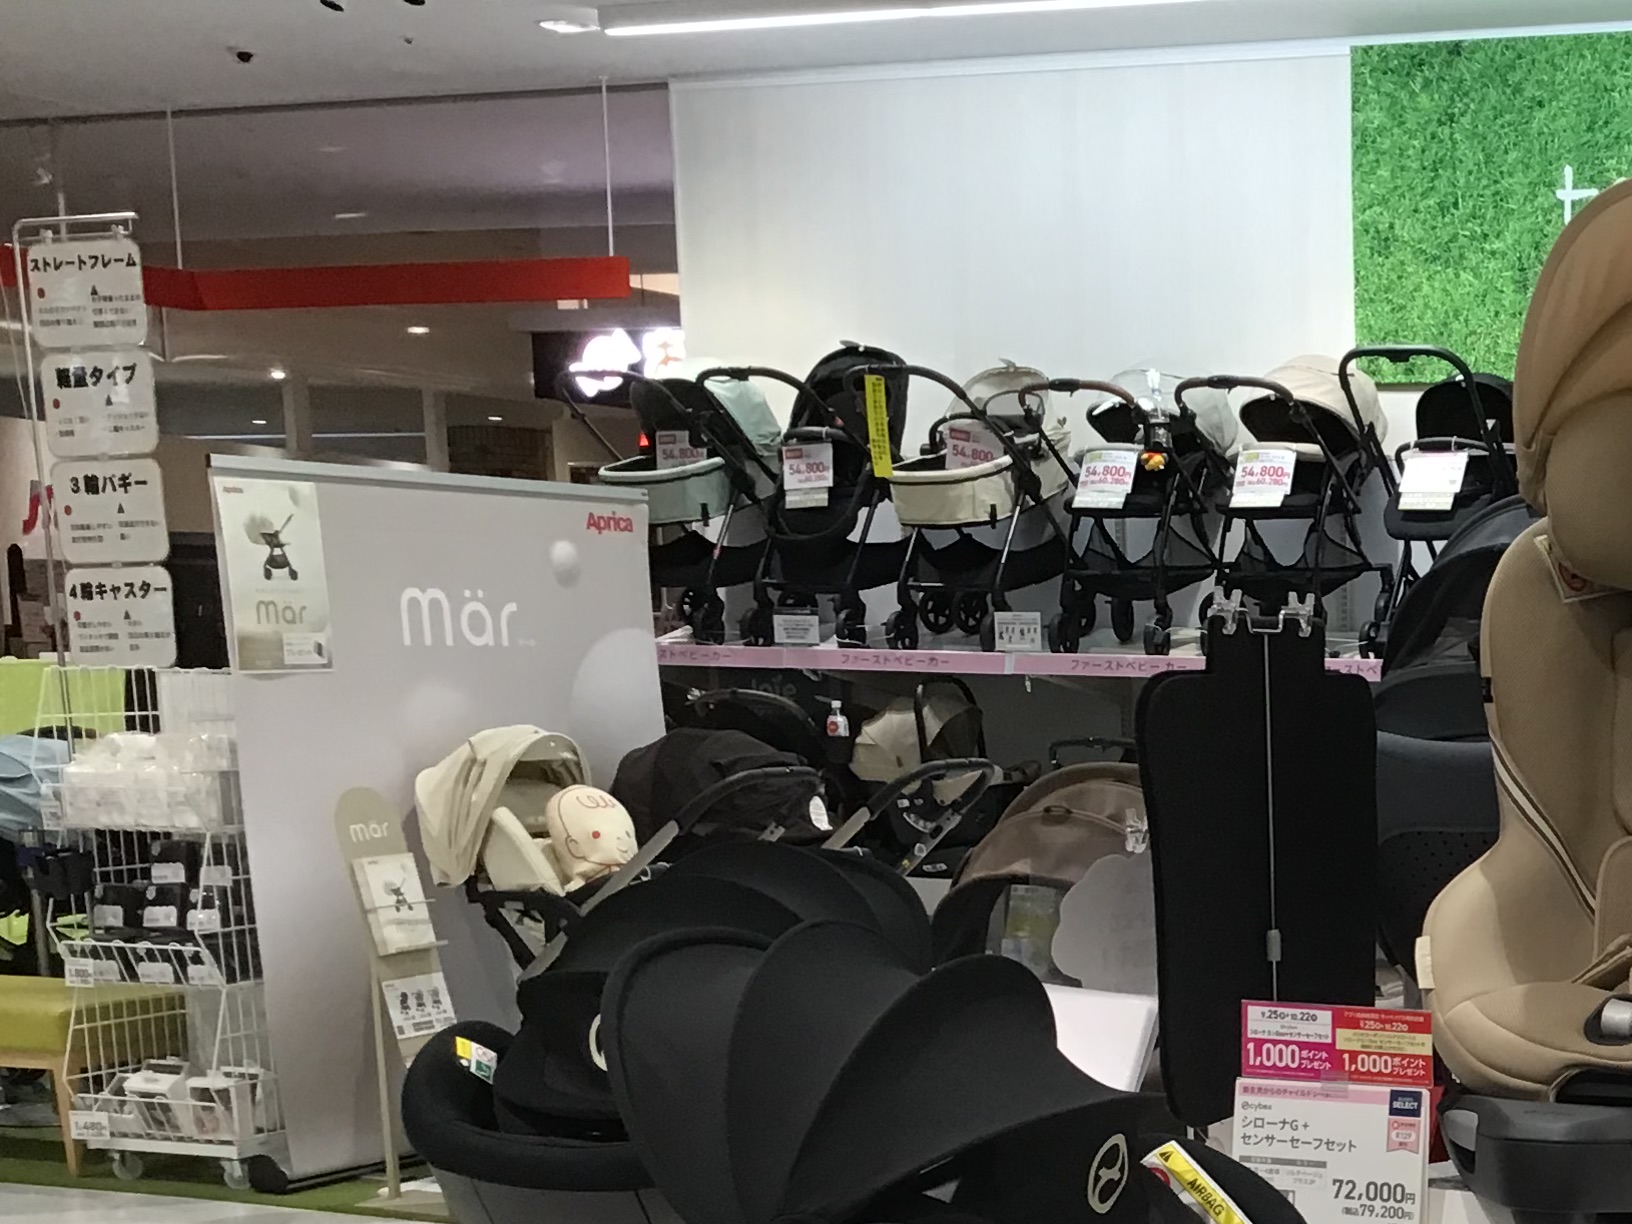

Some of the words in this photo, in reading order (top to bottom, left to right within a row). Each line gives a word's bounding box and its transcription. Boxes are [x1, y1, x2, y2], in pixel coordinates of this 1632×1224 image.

[30, 254, 137, 272] ストレートフレーム
[55, 363, 137, 389] 軽量タイプ
[586, 511, 634, 534] Aprica
[1247, 1042, 1299, 1068] 1,000
[1342, 1053, 1392, 1073] 1,000
[1241, 1133, 1357, 1153] センサーセーフセット
[1187, 1177, 1225, 1217] AIRBAG
[1332, 1179, 1416, 1205] 72,000円
